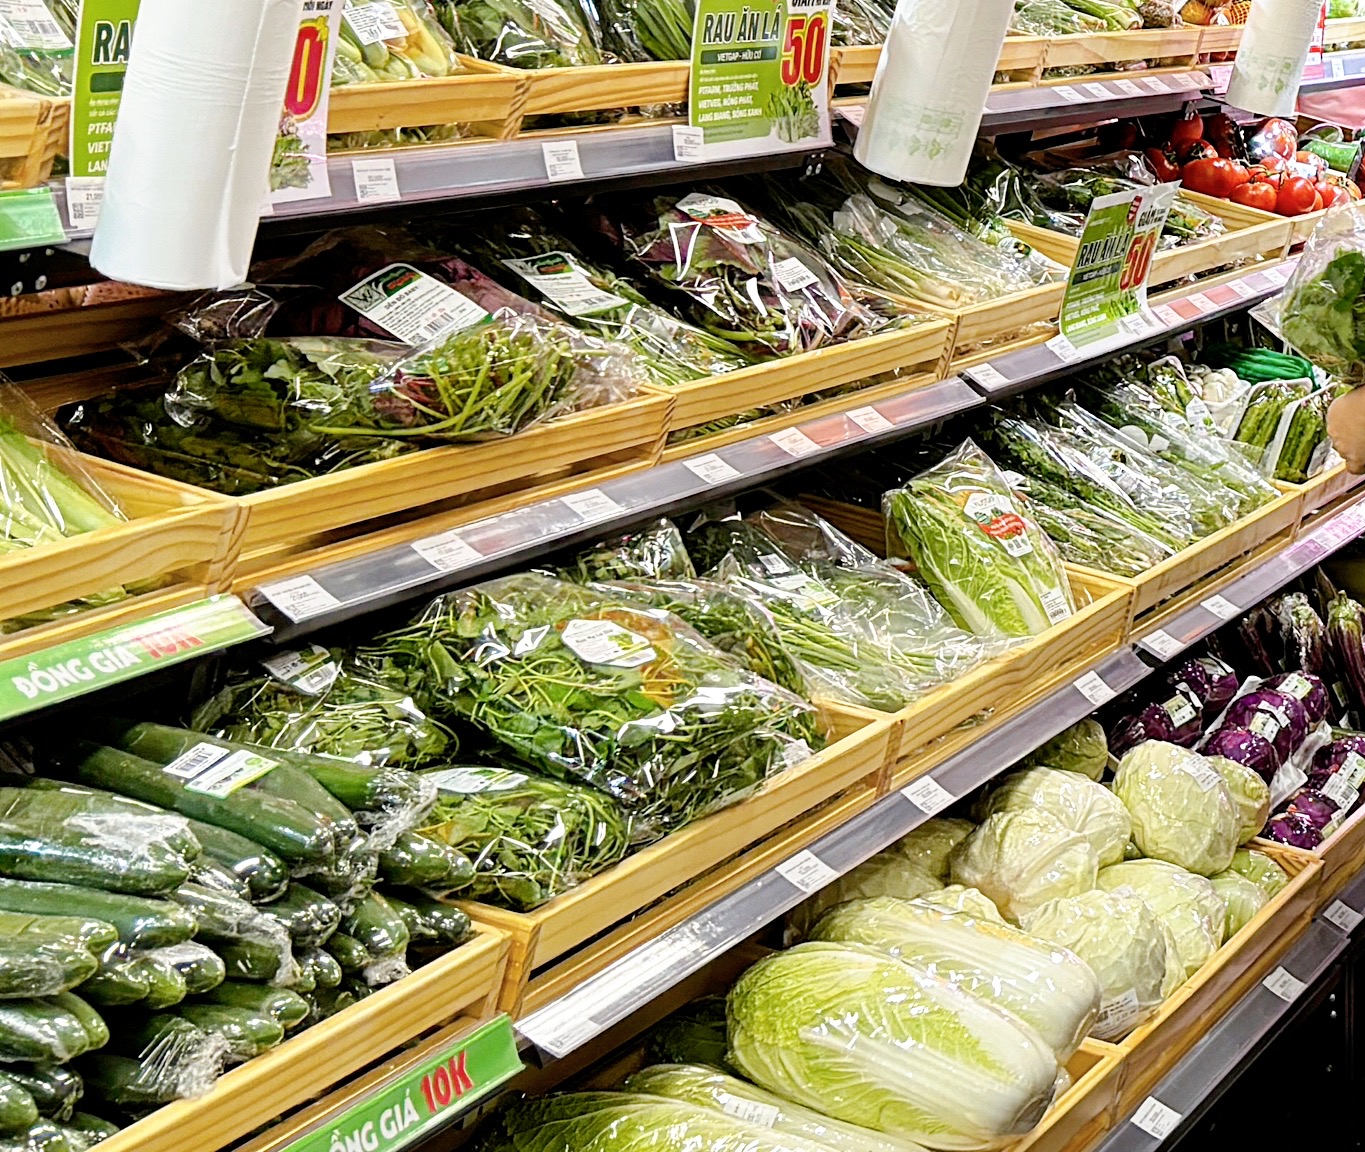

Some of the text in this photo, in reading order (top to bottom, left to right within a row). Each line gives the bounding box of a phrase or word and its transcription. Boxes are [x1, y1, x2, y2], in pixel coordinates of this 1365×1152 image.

[703, 5, 782, 44] RAU ĂN LÁ
[11, 662, 96, 699] ĐỒNG
[380, 1088, 420, 1145] GIÁ
[420, 1049, 474, 1114] 10K
